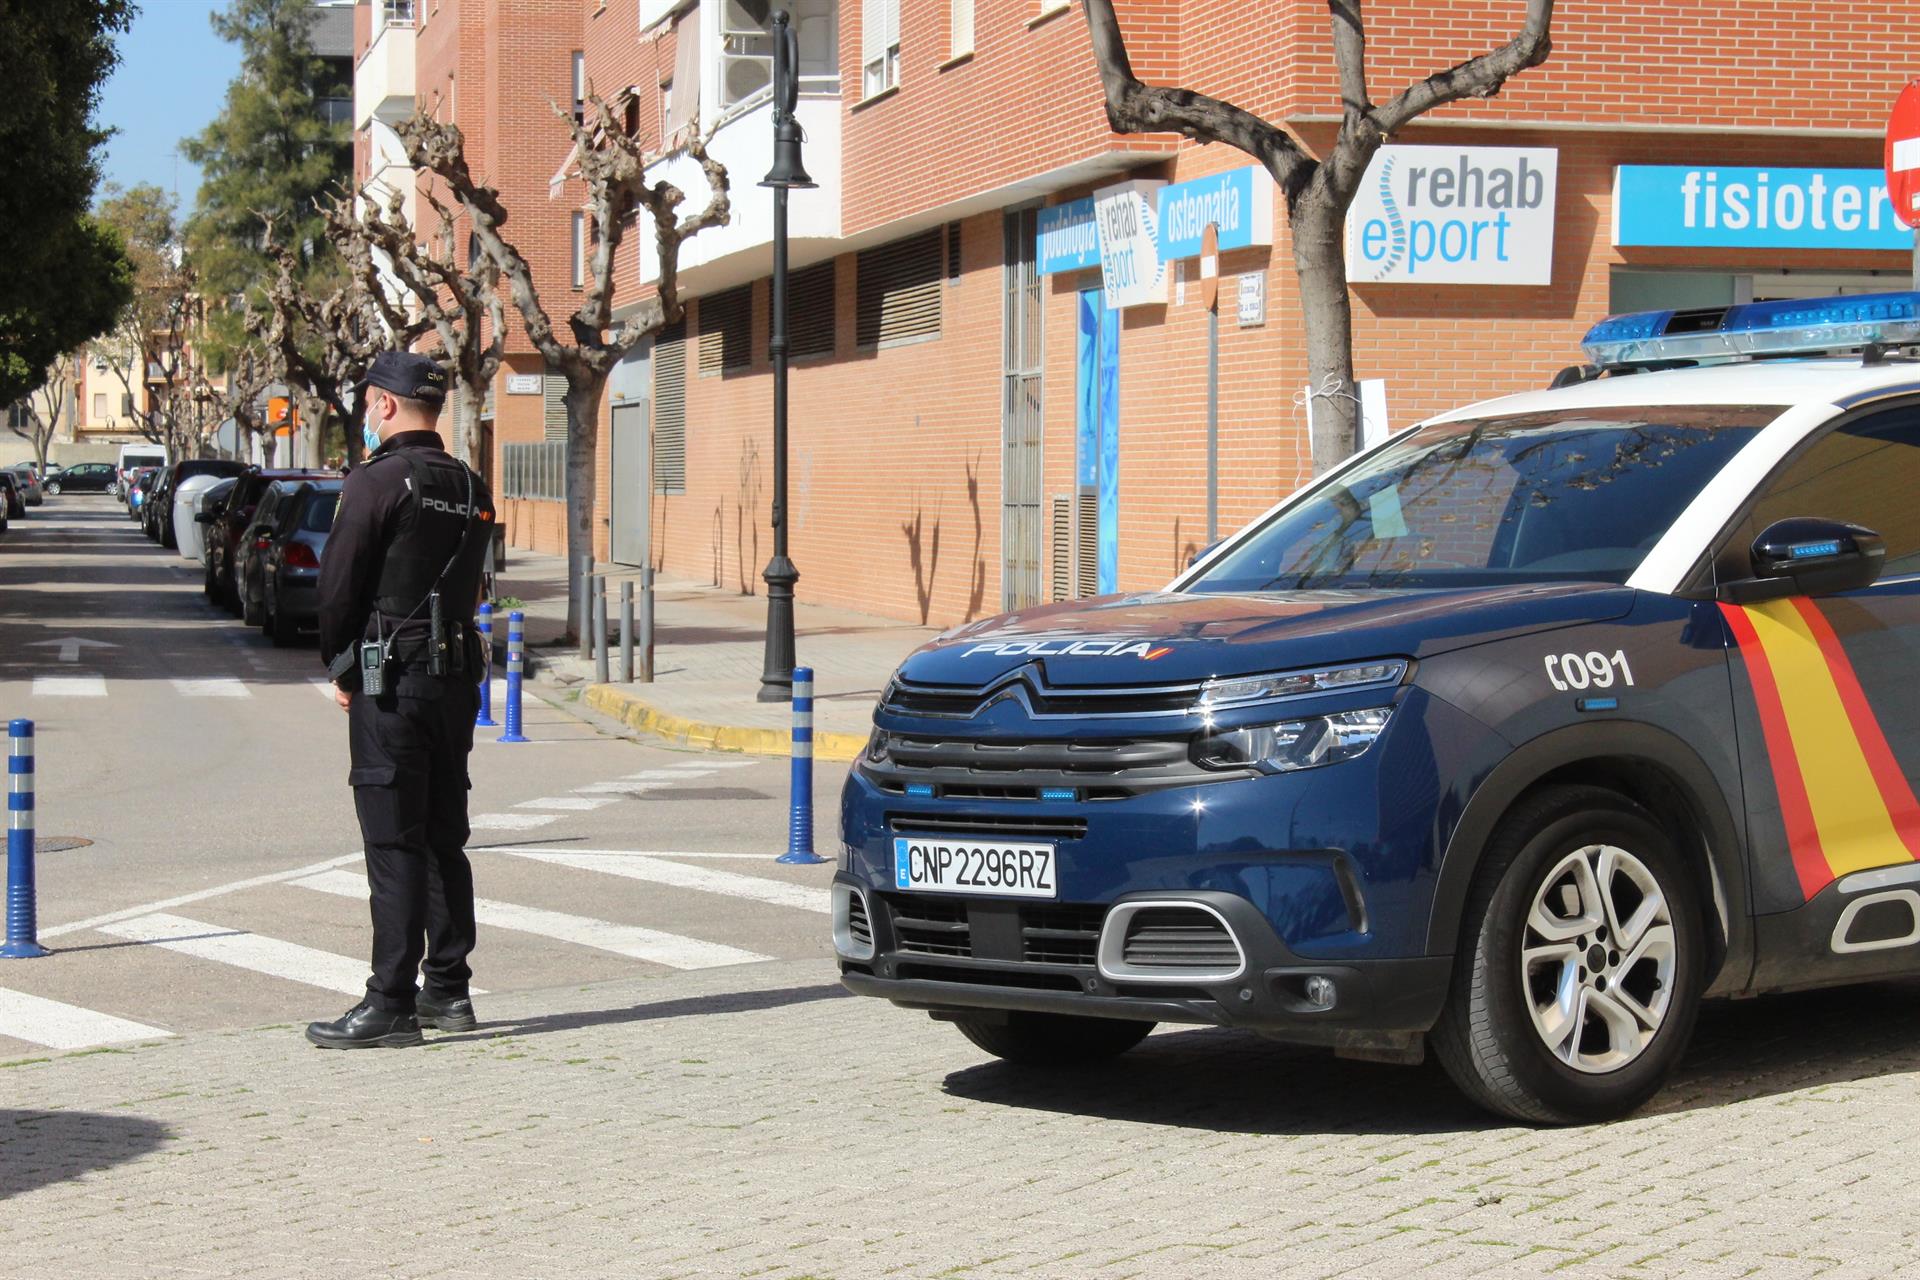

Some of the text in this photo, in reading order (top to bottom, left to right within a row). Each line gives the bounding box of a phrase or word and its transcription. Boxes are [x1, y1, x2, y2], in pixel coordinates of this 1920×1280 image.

[1407, 154, 1544, 210] rehab
[1681, 171, 1911, 233] fisioter
[1105, 190, 1138, 243] rehab
[422, 497, 481, 516] POLICA
[1561, 650, 1634, 690] 091
